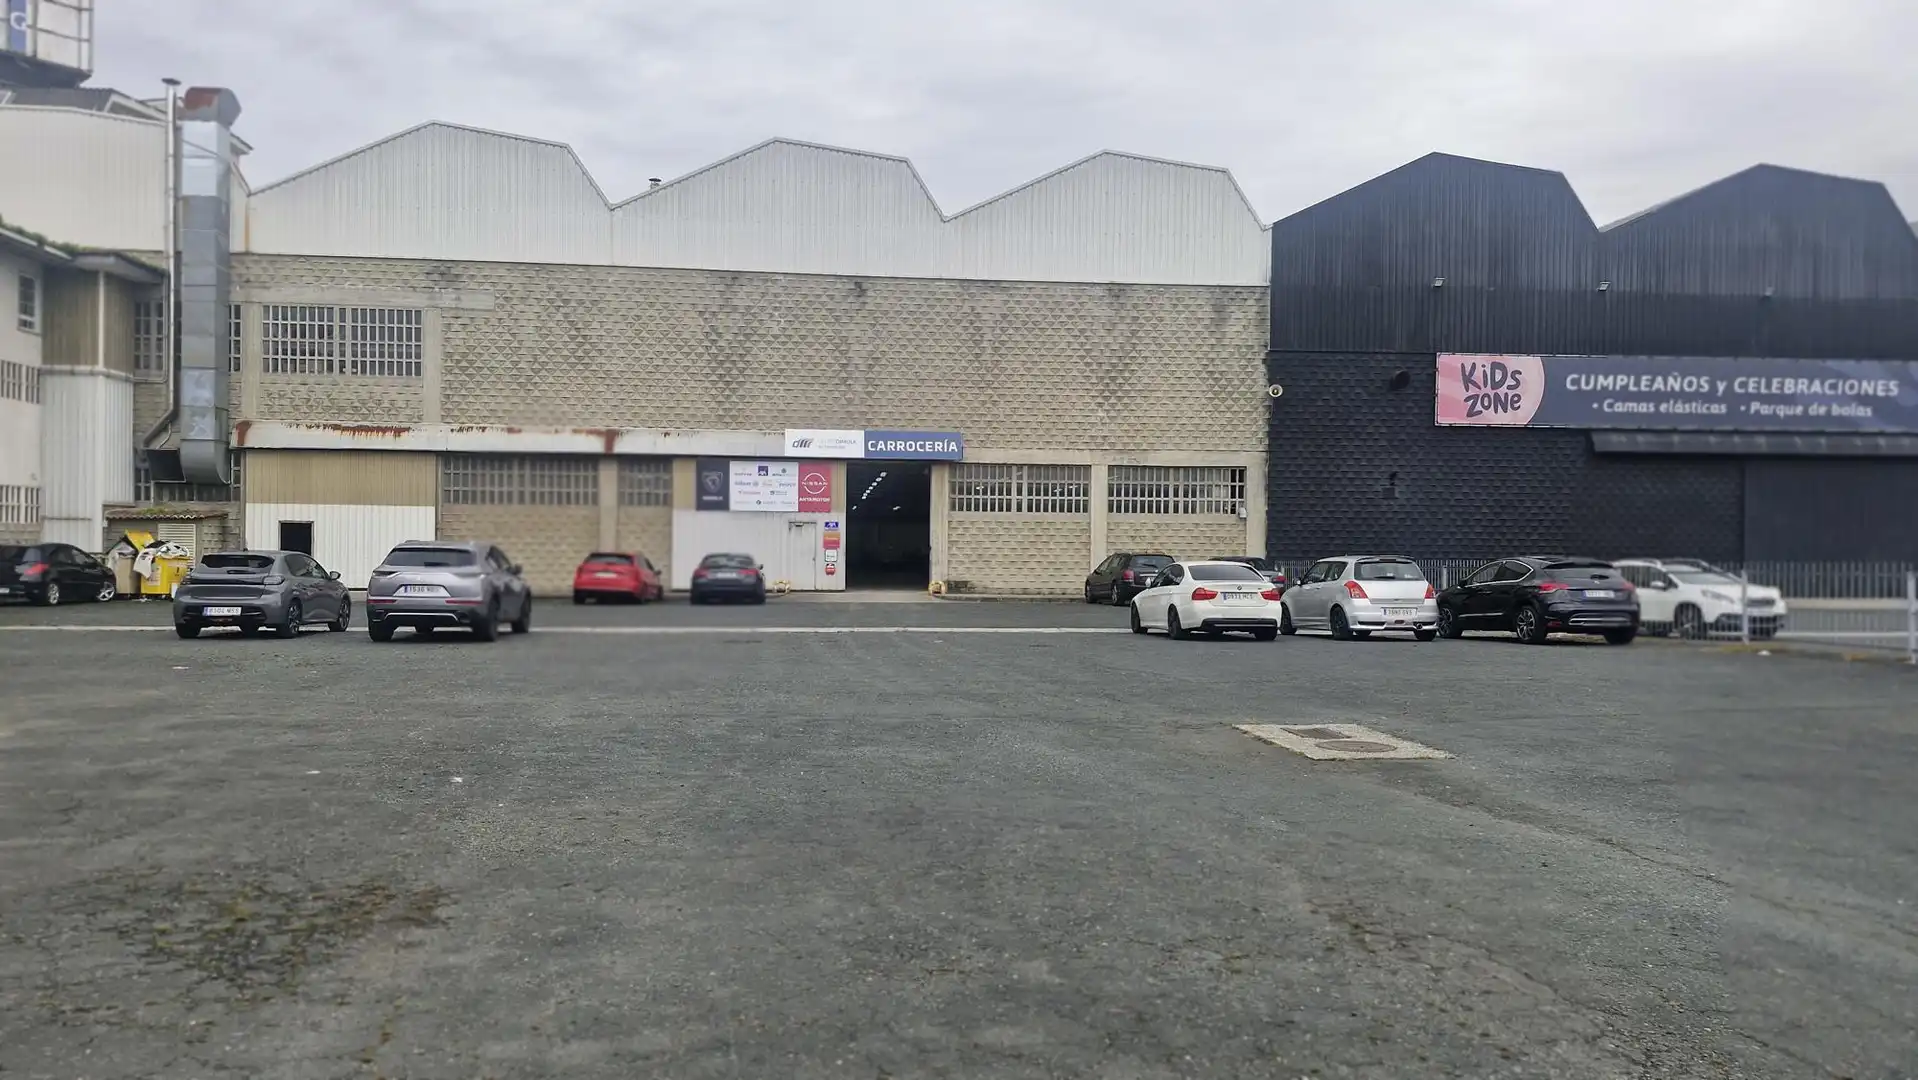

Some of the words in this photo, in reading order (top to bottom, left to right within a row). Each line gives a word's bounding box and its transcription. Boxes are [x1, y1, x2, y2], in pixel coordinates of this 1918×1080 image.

[1565, 371, 1710, 393] CUMPLEAÑOS
[1715, 379, 1727, 396] y
[1733, 376, 1900, 397] CELEBRACIONES
[1602, 398, 1656, 414] Camas
[1659, 398, 1727, 414] elásticas
[1750, 401, 1804, 419] Parque
[1808, 403, 1828, 416] de
[1831, 402, 1873, 418] bolas
[867, 438, 958, 453] CARROCERÍA
